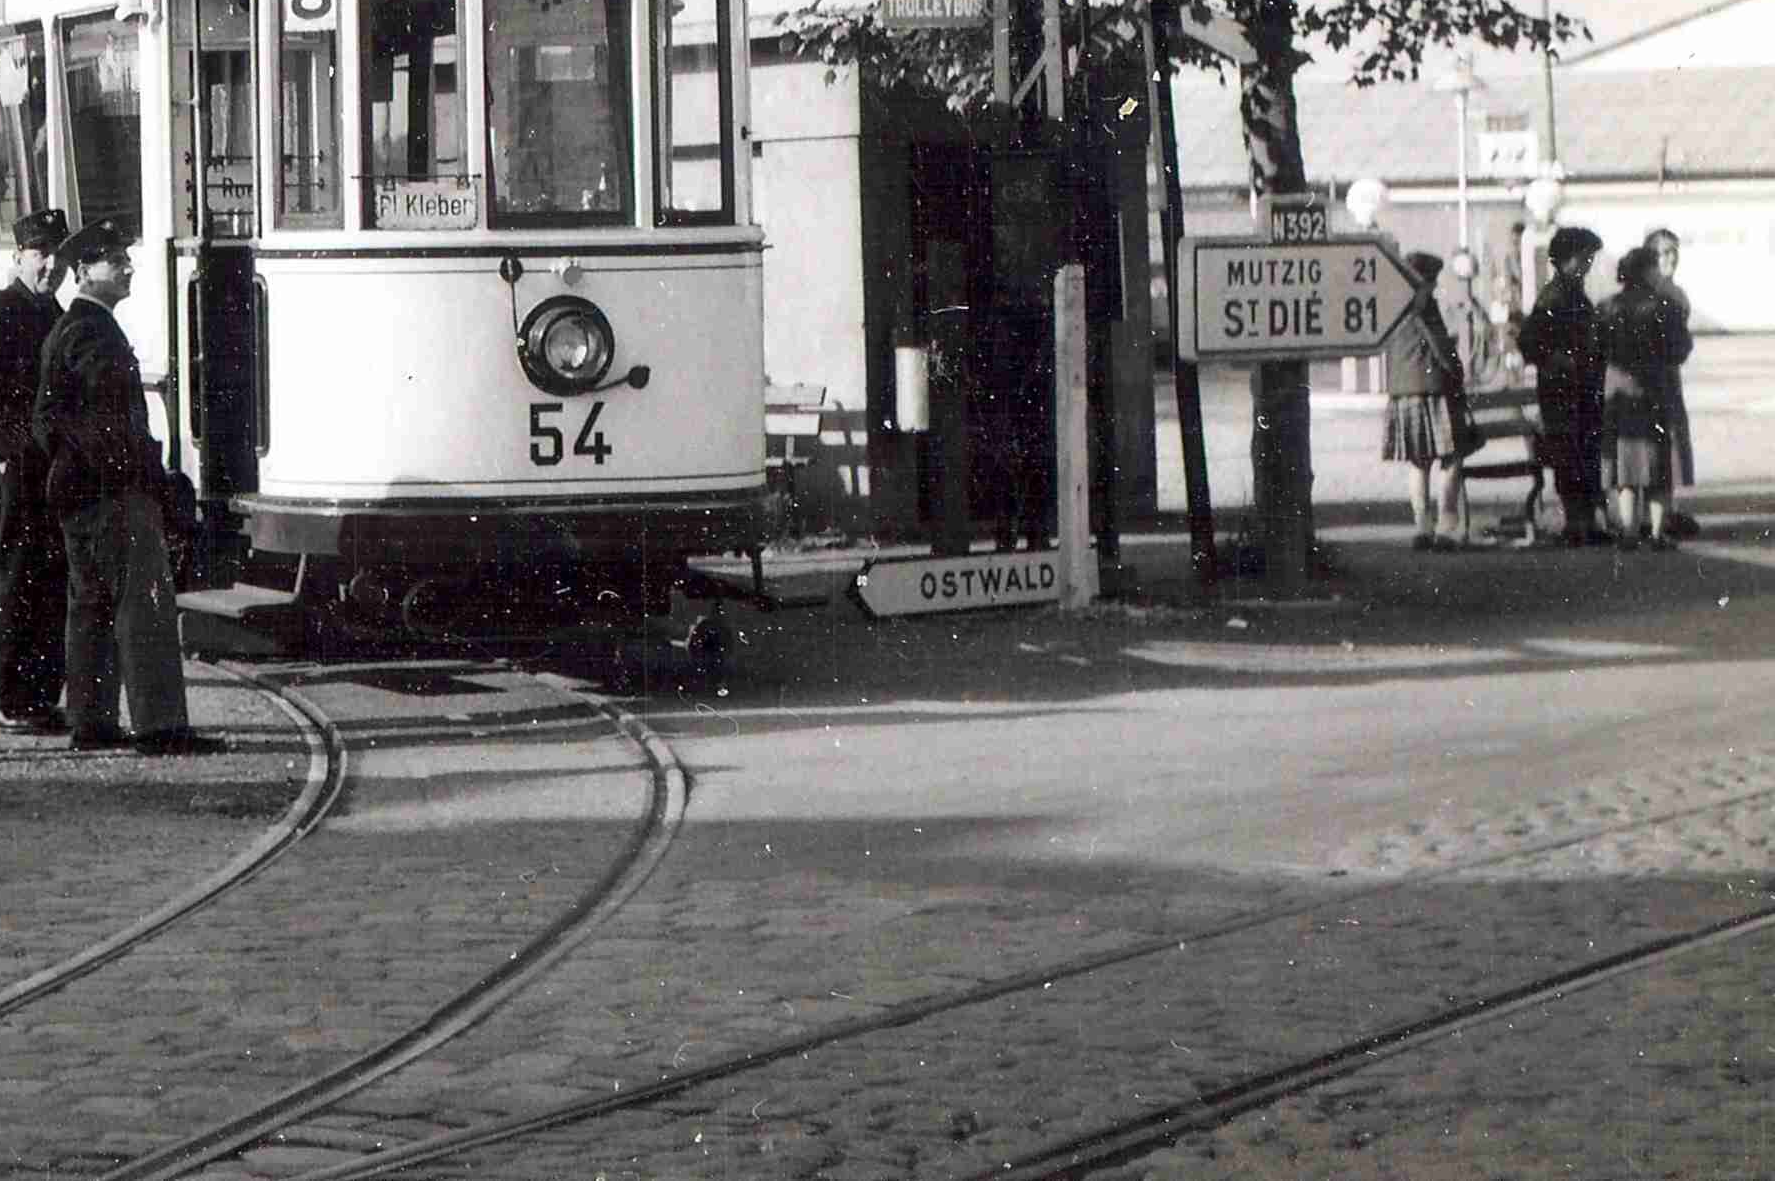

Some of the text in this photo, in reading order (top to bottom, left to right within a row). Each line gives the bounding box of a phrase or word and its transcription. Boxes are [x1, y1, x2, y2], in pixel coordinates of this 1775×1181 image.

[1273, 210, 1326, 242] N392
[1227, 258, 1377, 287] MUTZIG 21
[1269, 291, 1323, 336] DIÉ
[1344, 297, 1377, 334] 81
[530, 401, 613, 467] 54
[920, 563, 1055, 600] OSTWALD
